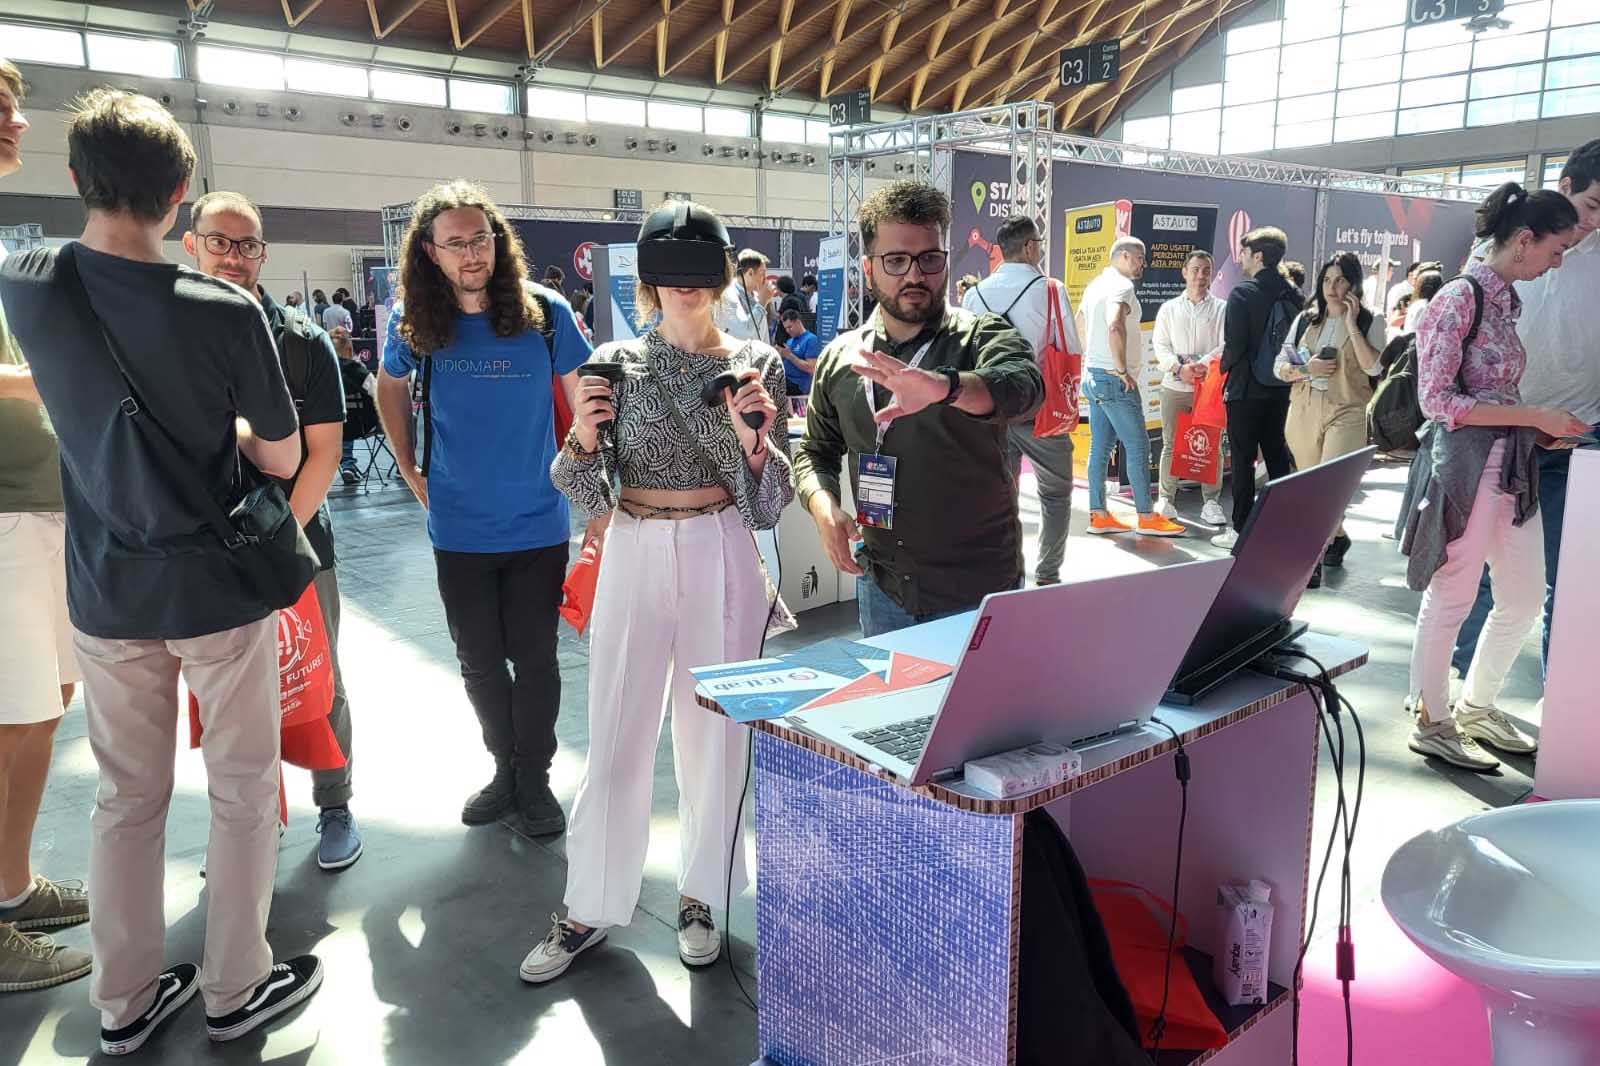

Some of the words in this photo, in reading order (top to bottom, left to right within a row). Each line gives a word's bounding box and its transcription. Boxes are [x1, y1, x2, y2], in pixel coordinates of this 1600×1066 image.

[1062, 59, 1083, 86] C3
[1103, 62, 1110, 79] 2
[831, 103, 846, 124] C3
[1154, 216, 1198, 228] ASTAUTO
[1336, 227, 1359, 244] Let's
[1361, 228, 1373, 248] fly
[1374, 230, 1409, 246] toards
